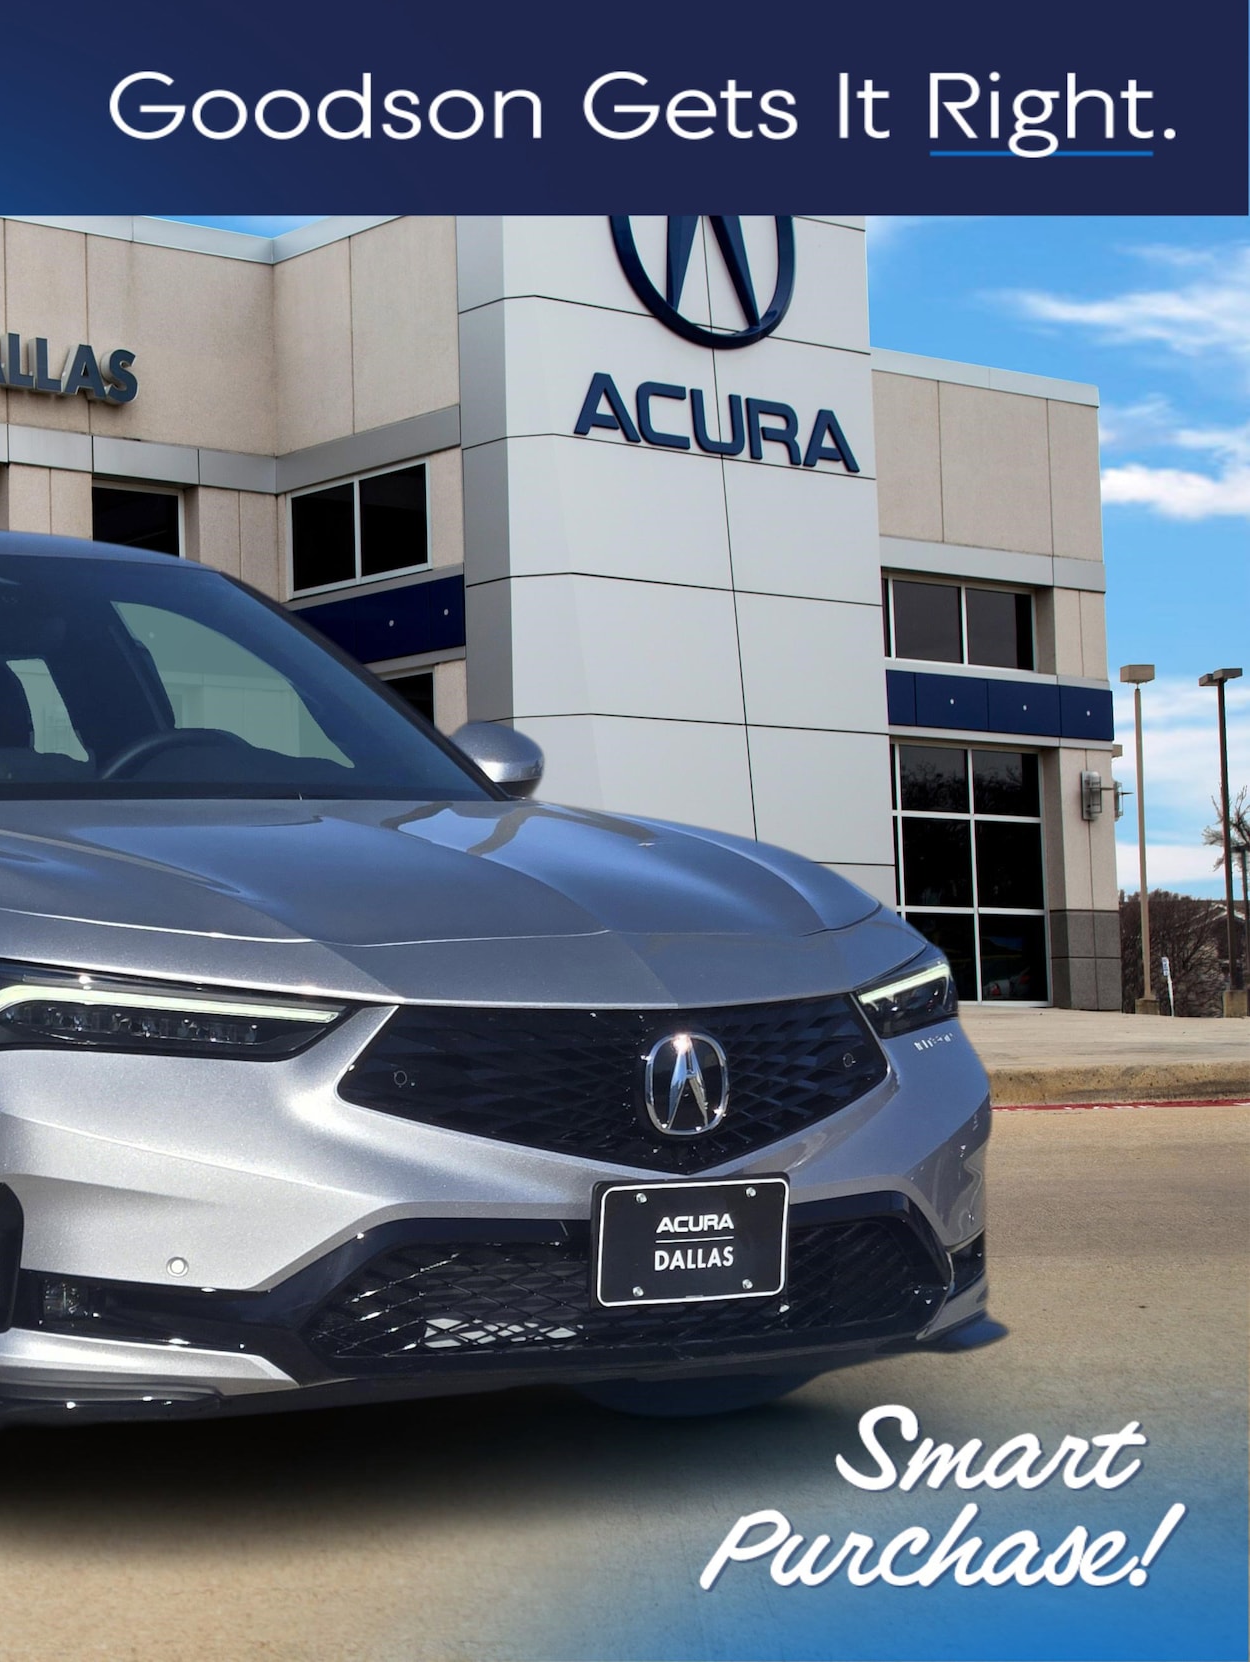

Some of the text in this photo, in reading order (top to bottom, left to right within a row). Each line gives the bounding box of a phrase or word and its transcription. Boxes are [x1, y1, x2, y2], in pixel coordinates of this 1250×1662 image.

[574, 372, 860, 473] ACURA
[655, 1213, 734, 1234] ACURA
[654, 1246, 734, 1271] DALLAS
